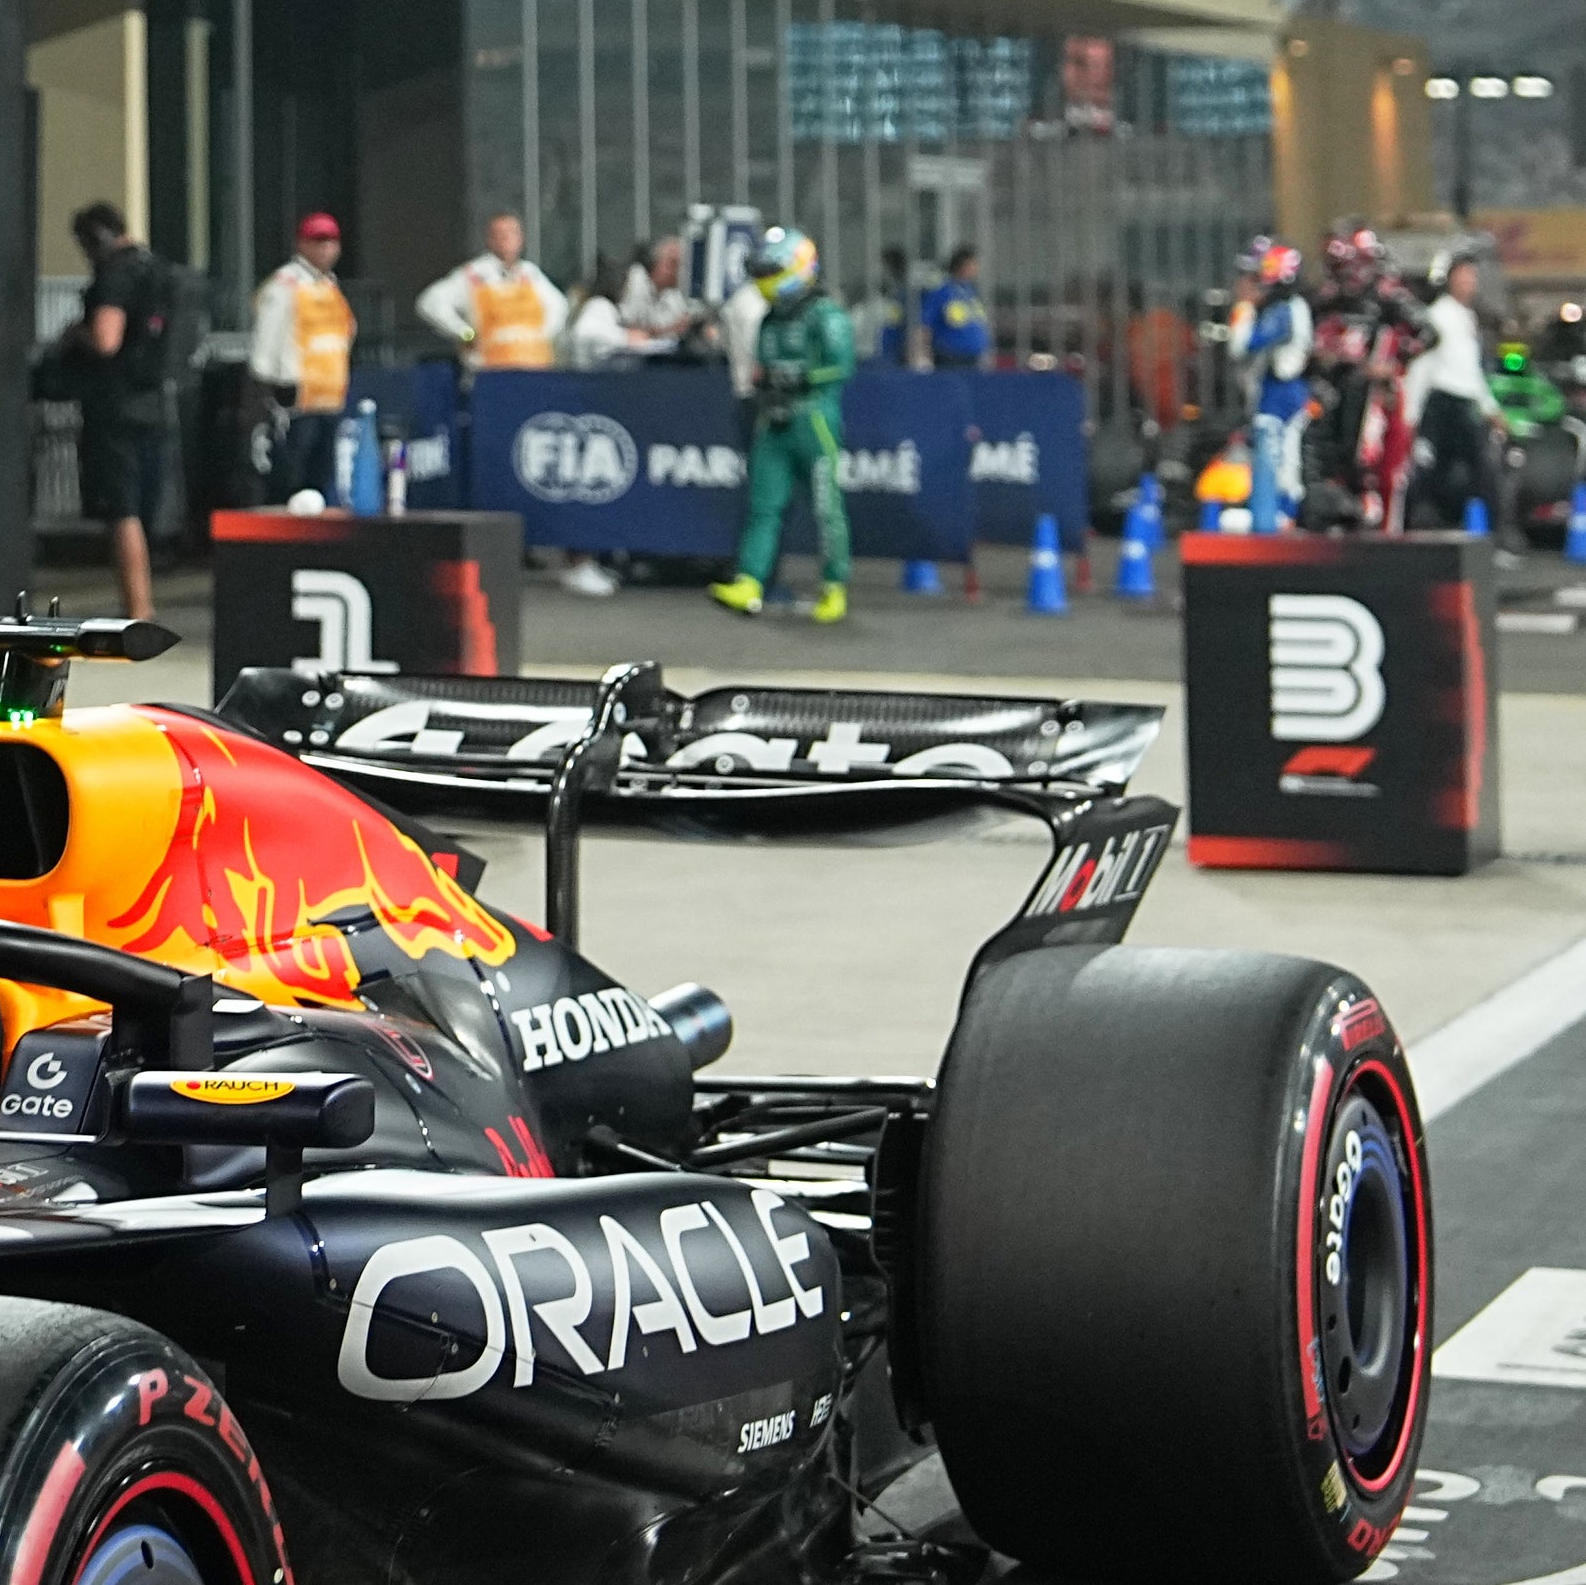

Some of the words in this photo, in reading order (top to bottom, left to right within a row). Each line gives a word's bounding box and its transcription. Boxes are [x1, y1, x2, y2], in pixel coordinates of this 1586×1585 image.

[521, 428, 625, 484] FIA
[647, 442, 749, 488] PAR
[291, 568, 399, 675] 1
[1268, 593, 1387, 743] 3
[1029, 832, 1131, 916] Mobil
[509, 987, 676, 1074] HONDA
[0, 1093, 74, 1119] Gate
[203, 1078, 280, 1093] RAUCH
[337, 1189, 824, 1401] ORACLE
[138, 1367, 169, 1426] P
[736, 1409, 796, 1454] SIEMENS
